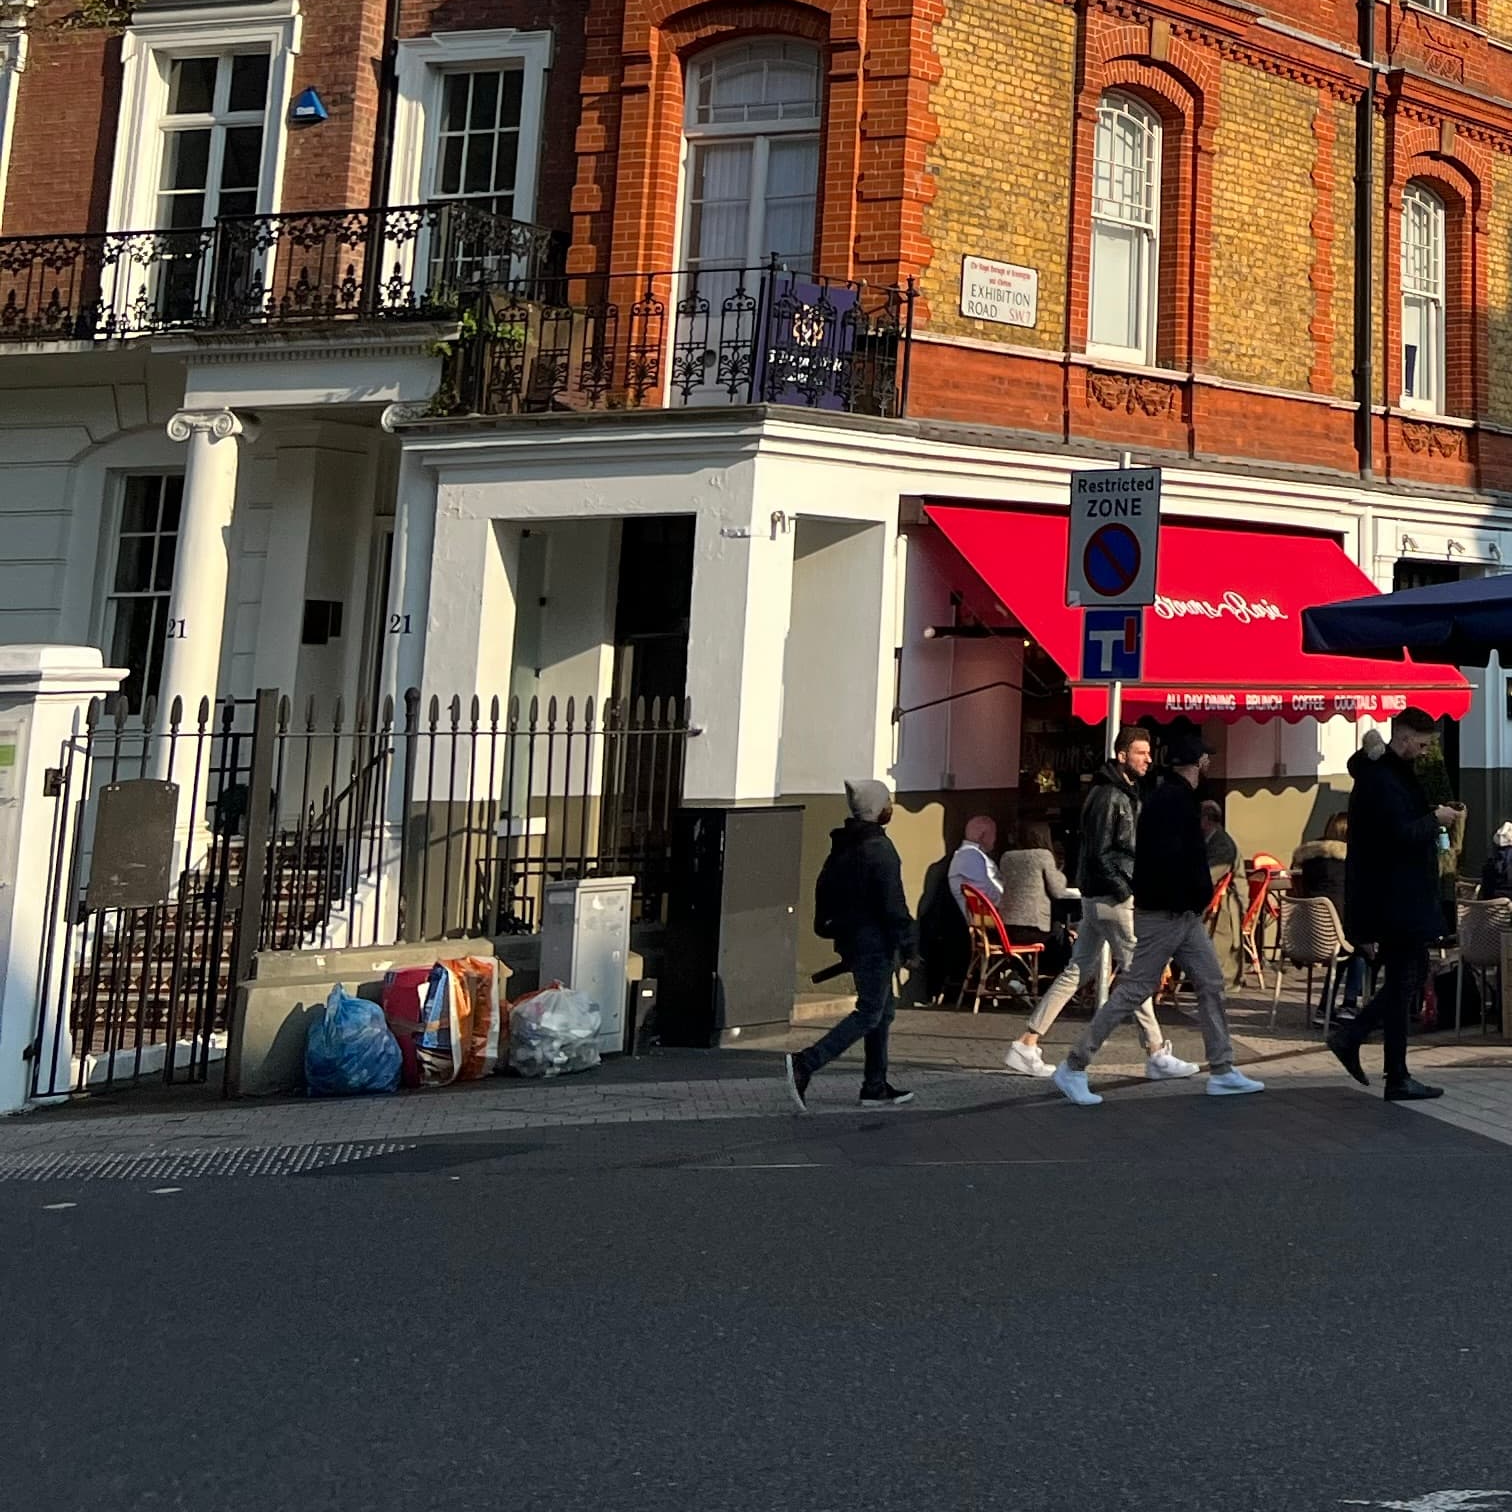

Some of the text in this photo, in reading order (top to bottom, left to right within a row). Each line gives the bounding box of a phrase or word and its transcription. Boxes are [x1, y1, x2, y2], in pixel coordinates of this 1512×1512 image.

[971, 284, 1031, 307] EXHIBITION
[968, 300, 997, 318] ROAD
[1078, 475, 1154, 494] Restricted
[1086, 497, 1143, 518] ZONE
[167, 618, 188, 639] 21
[389, 614, 412, 635] 21
[1165, 692, 1407, 711] ALL DAY DINING BRUNCH COFFEE COCKTAILS WINES
